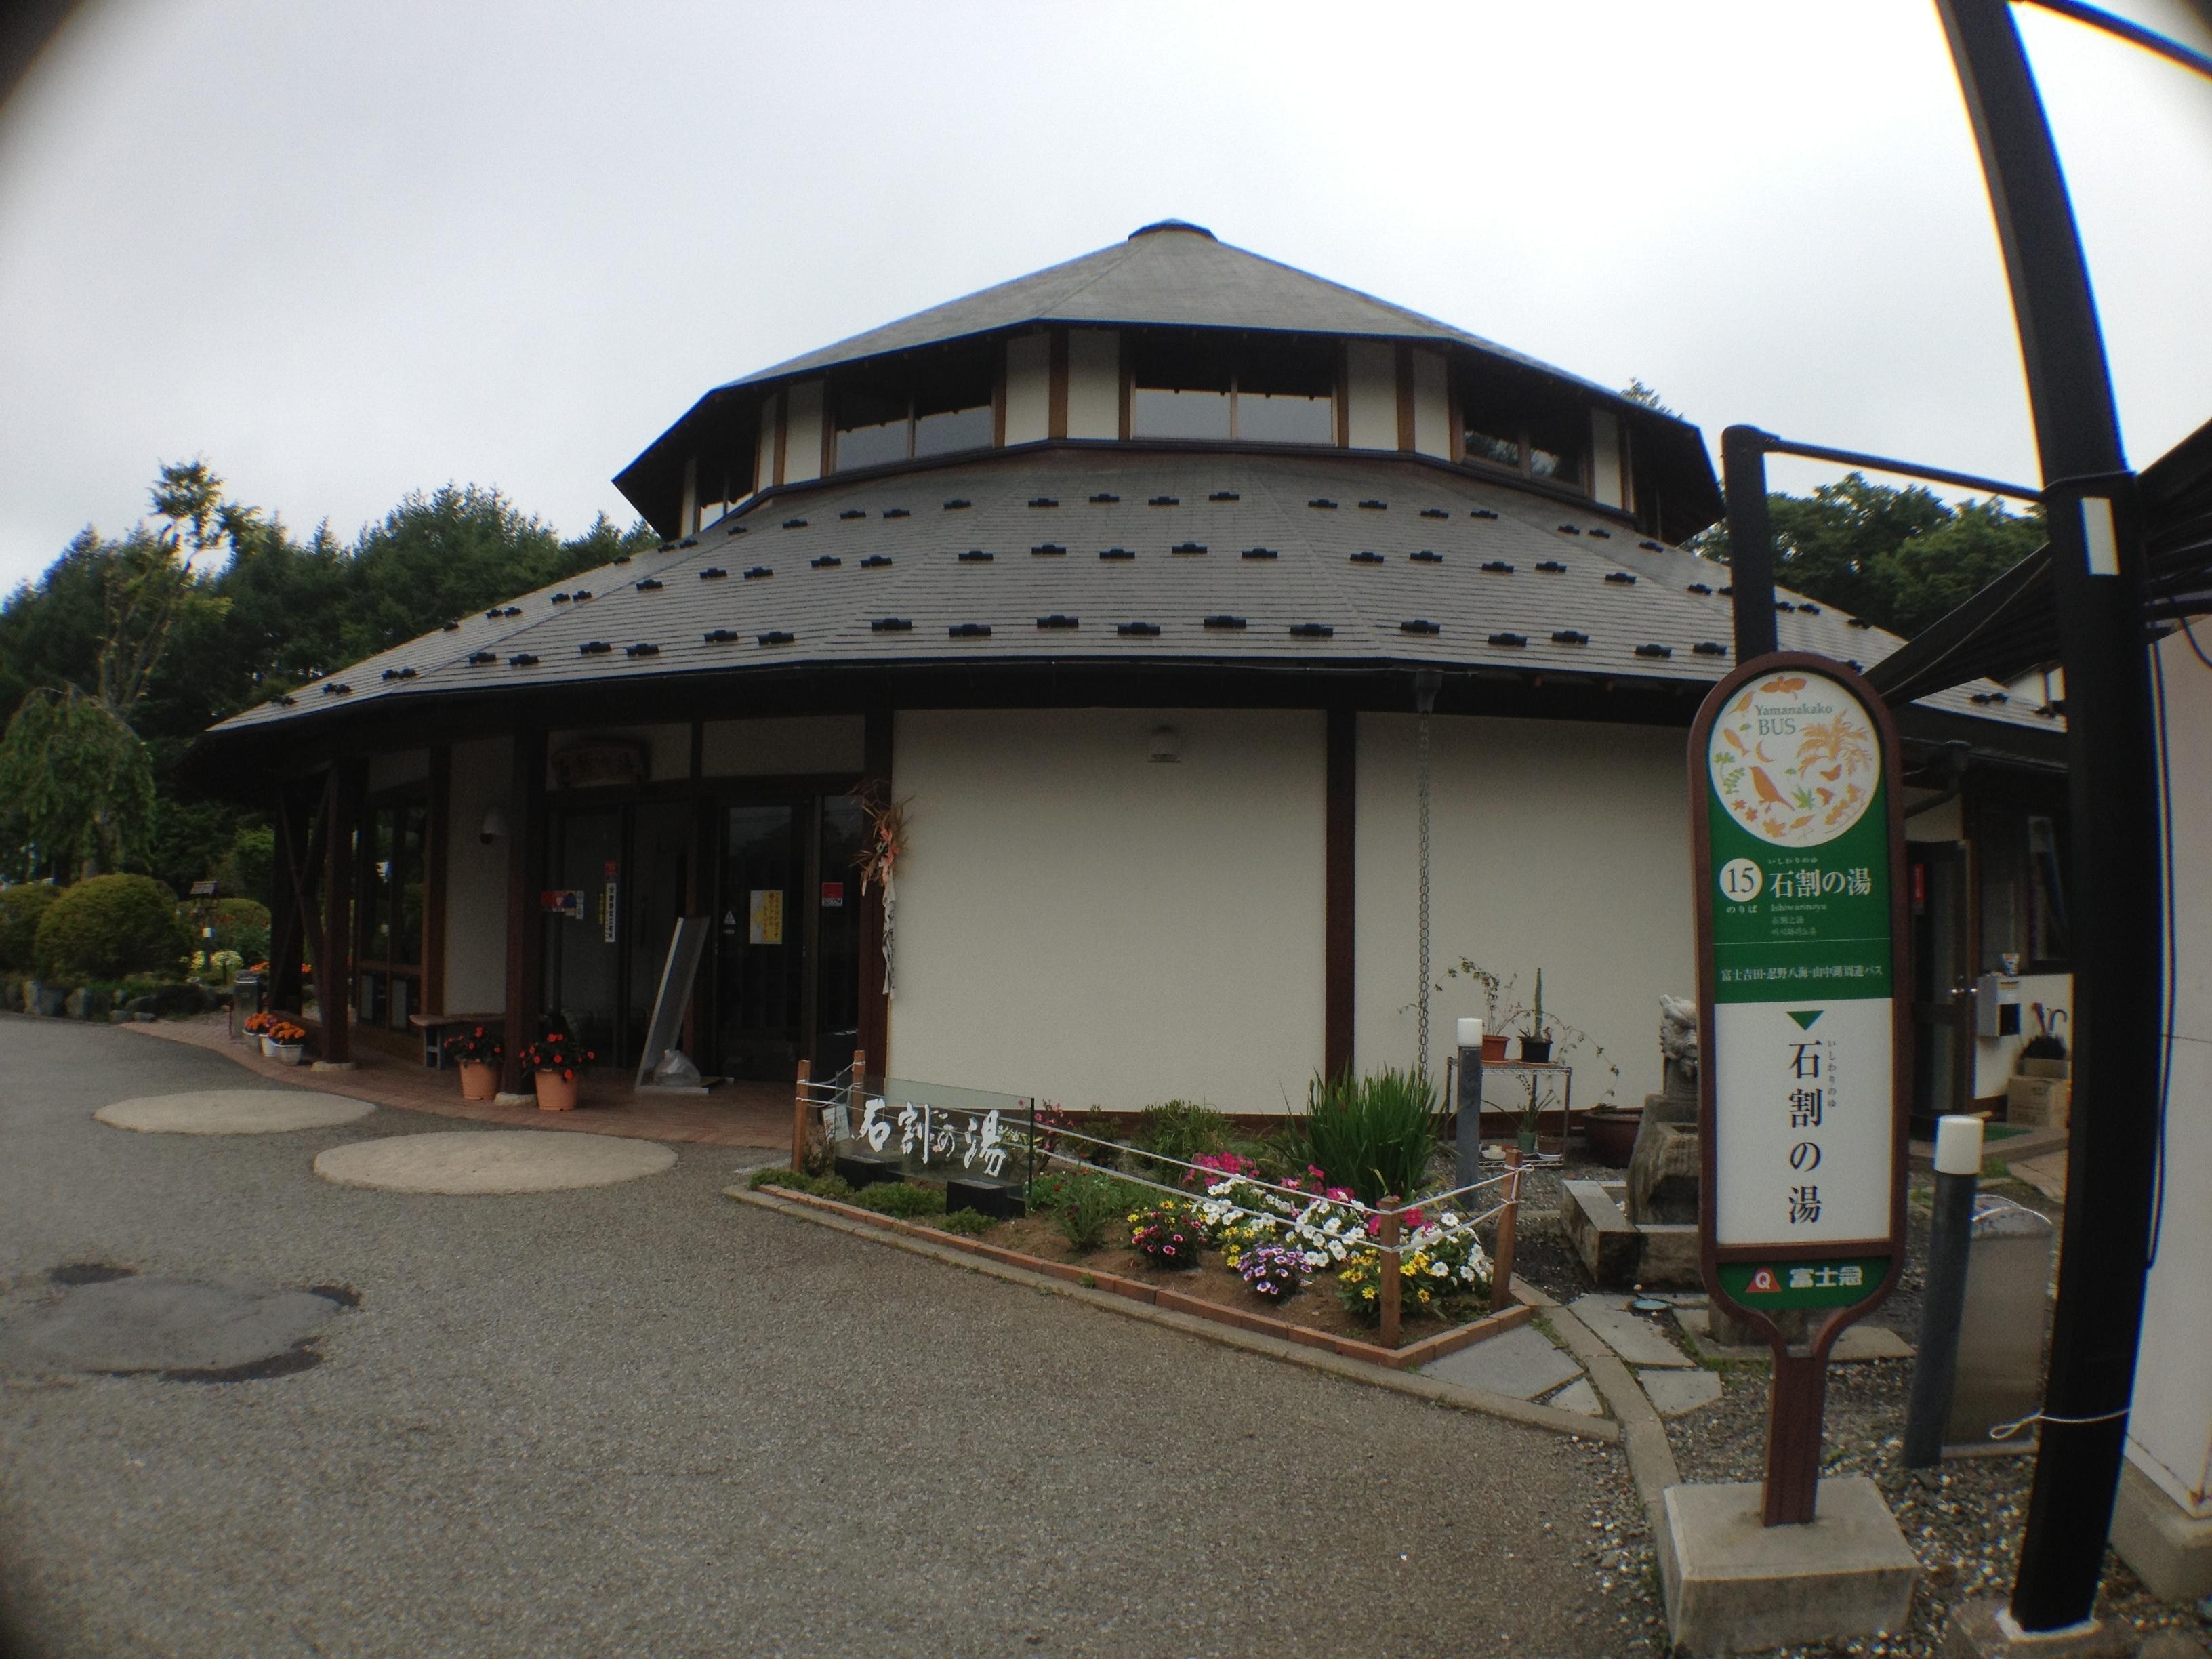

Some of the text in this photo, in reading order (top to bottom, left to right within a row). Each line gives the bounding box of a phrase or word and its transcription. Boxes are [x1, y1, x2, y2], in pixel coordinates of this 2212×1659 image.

[1755, 703, 1833, 716] Yamanakako
[1759, 718, 1795, 735] BUS
[1727, 867, 1755, 893] 15
[1769, 867, 1872, 899] 石割の湯
[1726, 905, 1757, 914] のりば
[855, 1098, 1007, 1177] 石割の湯
[1788, 1040, 1822, 1224] 石割の湯
[1790, 1266, 1863, 1288] 富士急
